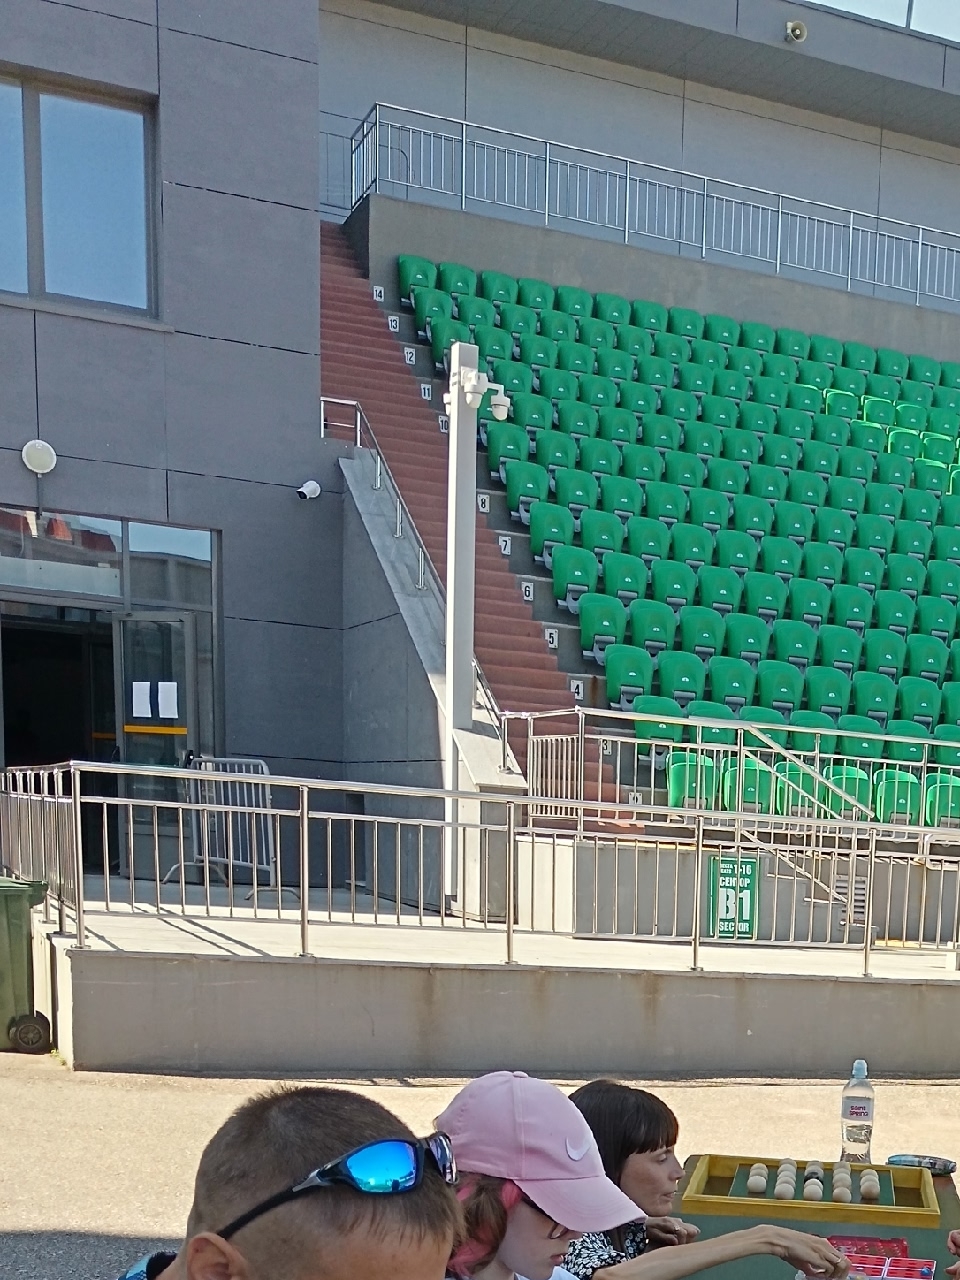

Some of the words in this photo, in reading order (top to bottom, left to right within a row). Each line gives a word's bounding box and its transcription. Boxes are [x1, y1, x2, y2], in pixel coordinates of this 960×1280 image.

[375, 289, 383, 299] 14
[390, 319, 398, 330] 13
[406, 351, 414, 362] 12
[423, 387, 431, 397] 11
[719, 922, 750, 932] SECOR
